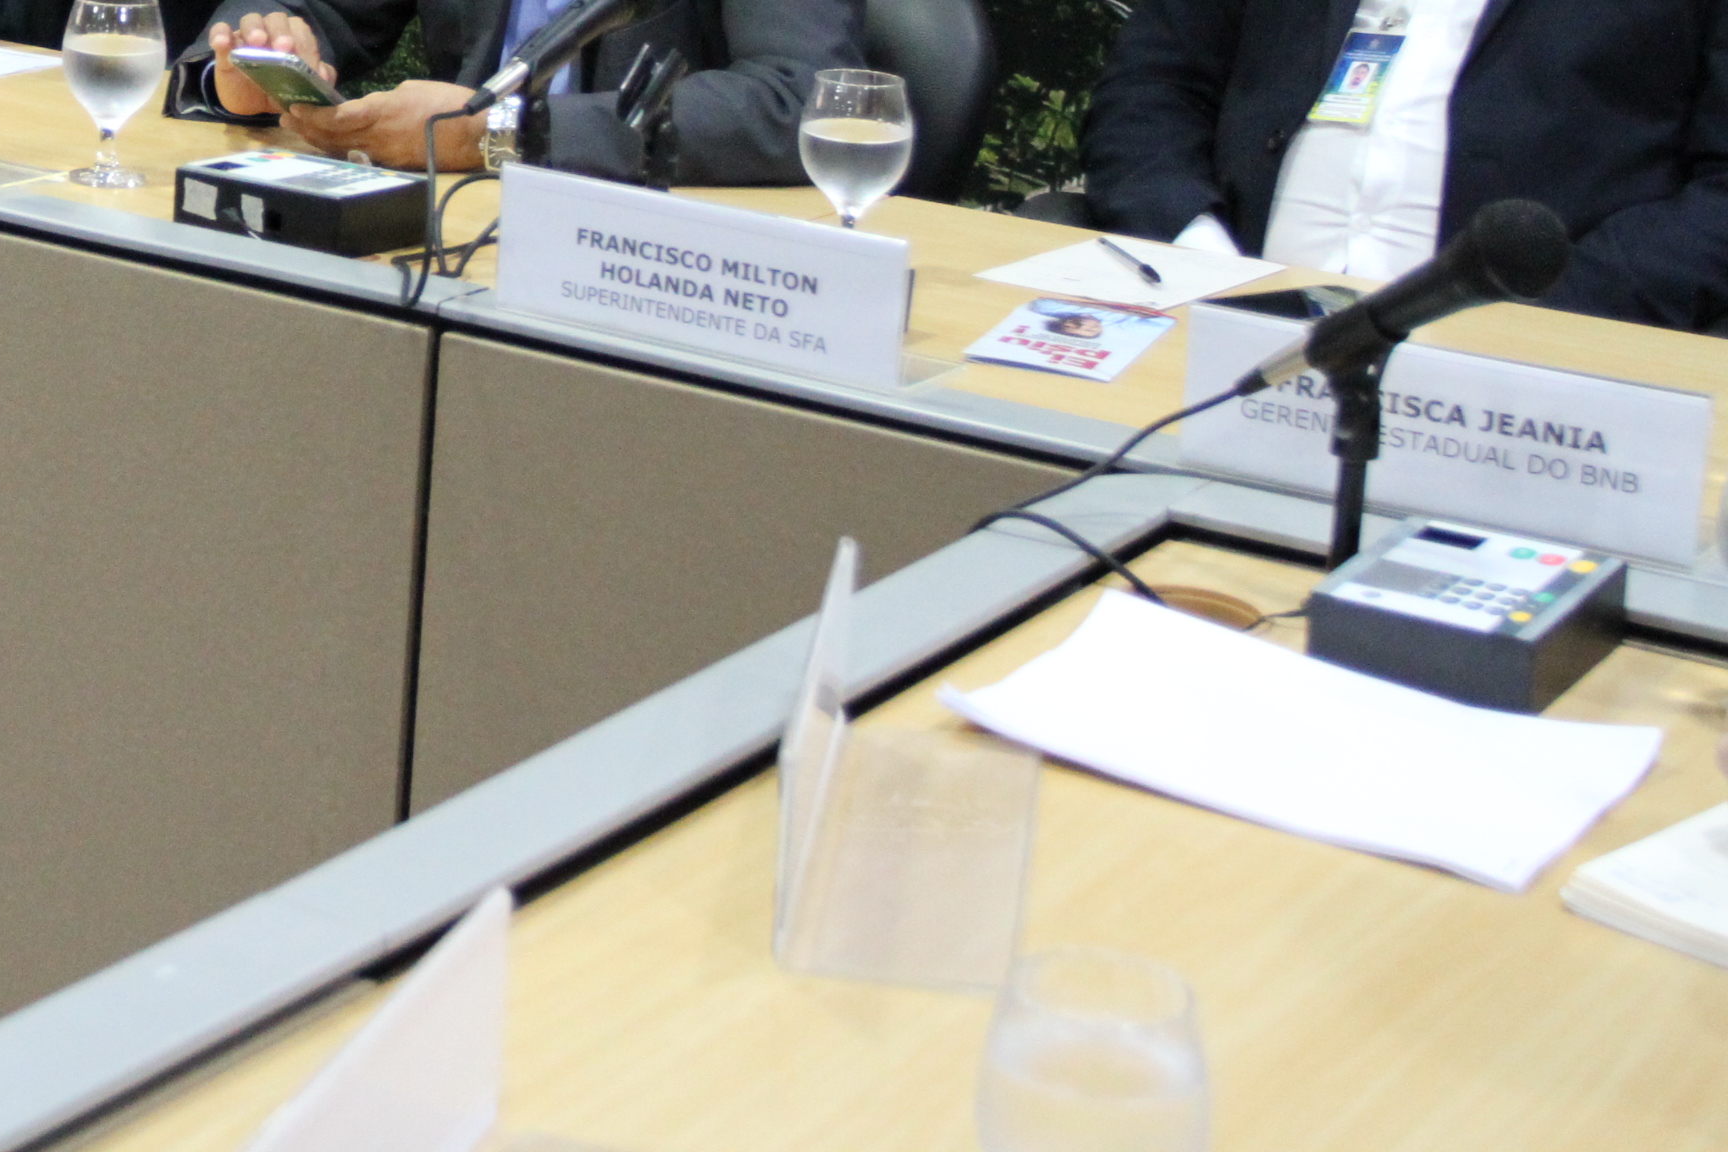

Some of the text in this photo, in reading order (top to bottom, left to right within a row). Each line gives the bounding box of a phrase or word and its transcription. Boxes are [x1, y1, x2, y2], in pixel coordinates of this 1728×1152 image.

[576, 227, 818, 295] FRANCISCO MILTON
[600, 261, 789, 318] HOLANDA NETO
[561, 281, 827, 355] SUPERINTENDENTE DA SFA
[1478, 408, 1608, 456] JEANIA
[1527, 455, 1570, 480] DO
[1580, 465, 1640, 495] BNB
